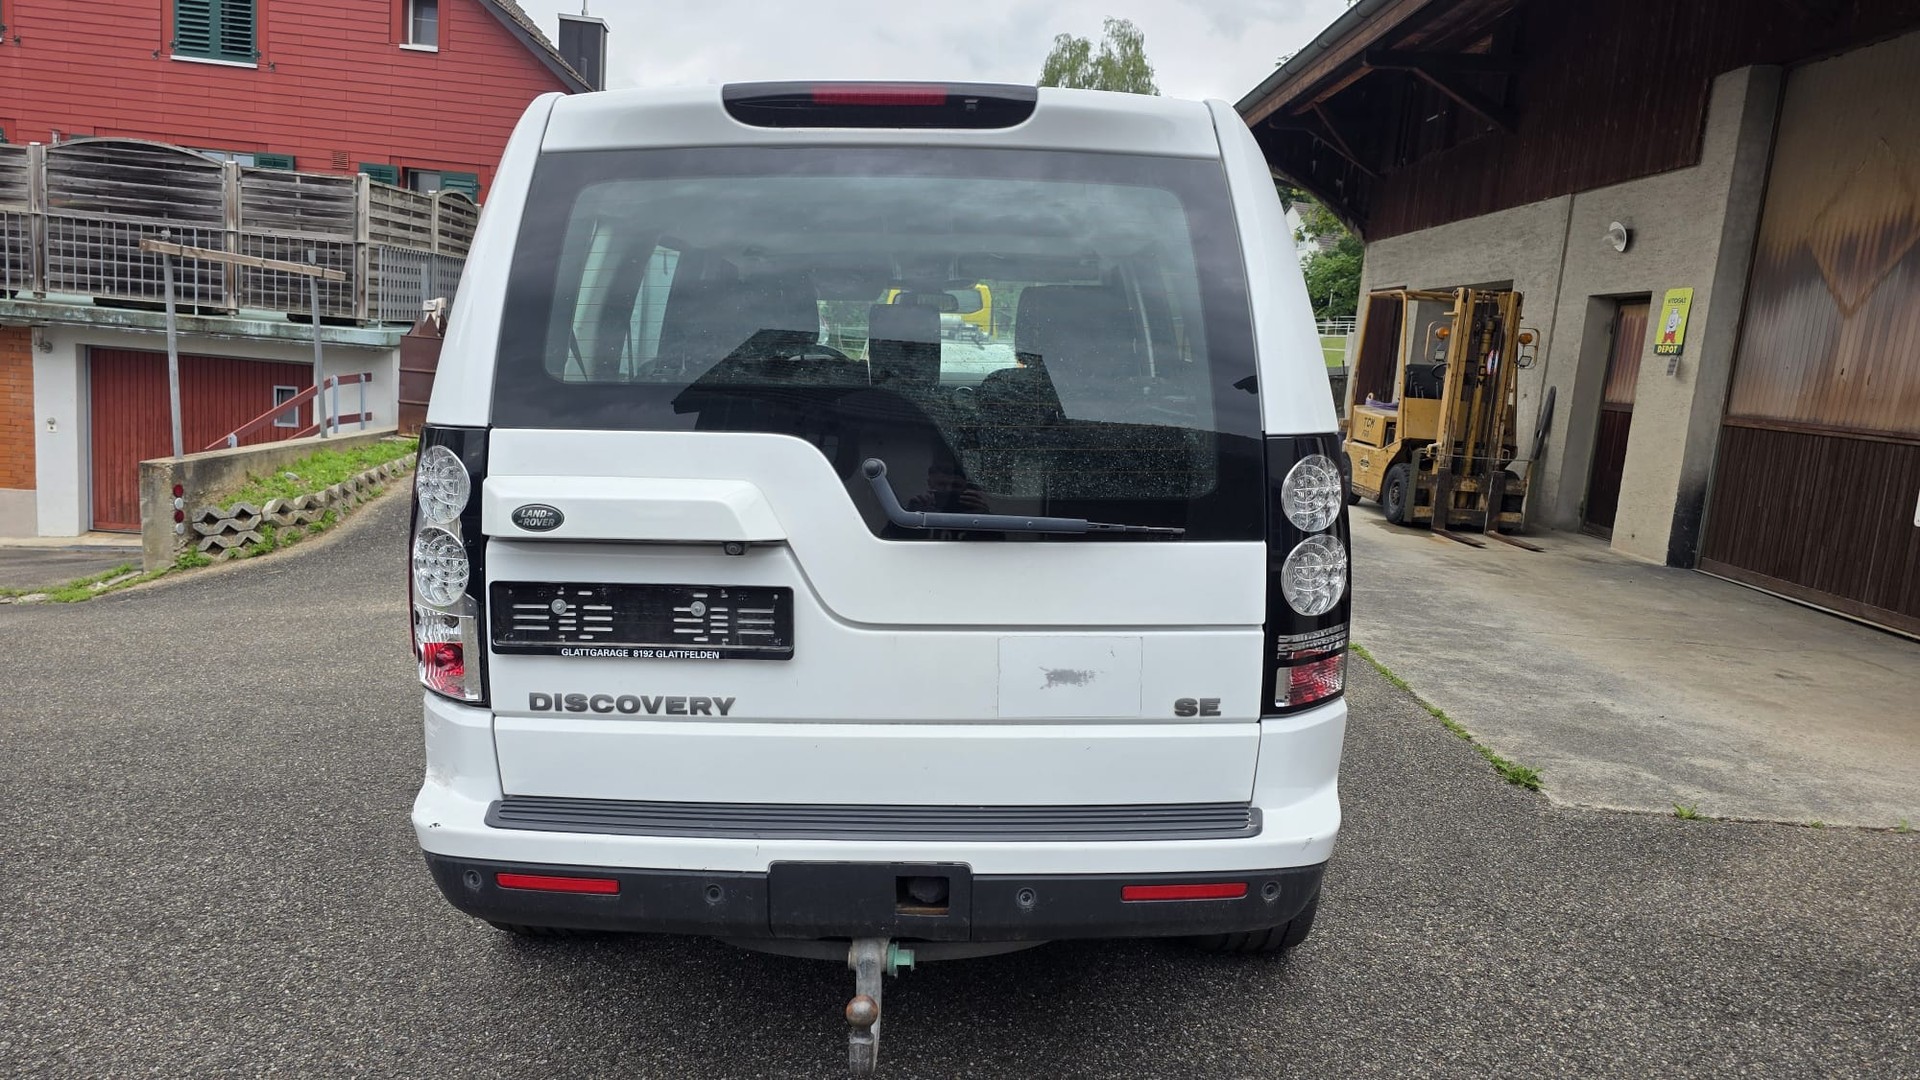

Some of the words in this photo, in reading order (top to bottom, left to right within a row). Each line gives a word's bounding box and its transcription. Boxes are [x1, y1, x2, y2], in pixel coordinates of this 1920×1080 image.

[1657, 345, 1678, 354] DEPOT
[561, 648, 629, 657] GLATTGARAGE
[633, 649, 654, 658] 8192
[656, 650, 720, 659] GLATTFELDEN
[529, 692, 736, 716] DISCOVERY
[1174, 697, 1221, 717] SE
